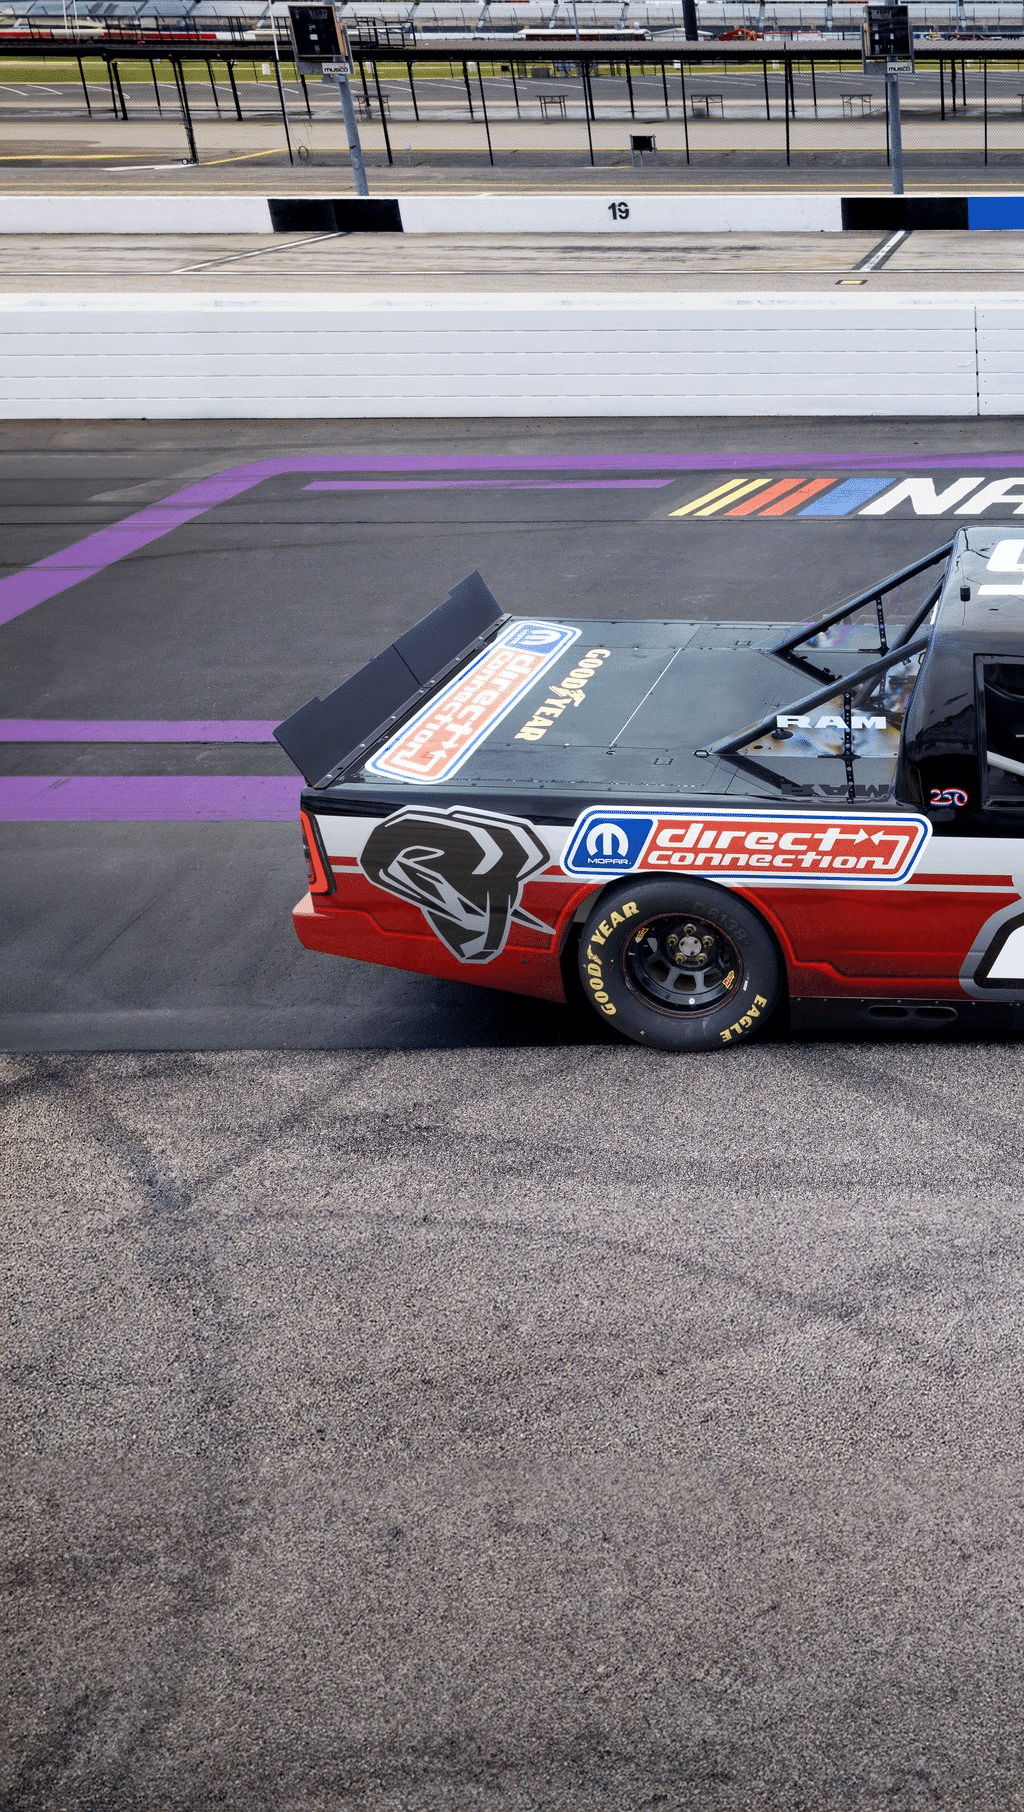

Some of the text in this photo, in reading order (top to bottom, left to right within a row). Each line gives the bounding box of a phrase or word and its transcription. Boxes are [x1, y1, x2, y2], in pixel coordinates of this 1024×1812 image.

[608, 202, 630, 220] 19
[444, 652, 542, 740] direct
[513, 648, 611, 741] GOODYEAR
[776, 714, 887, 730] RAM
[655, 823, 845, 851] direct
[587, 857, 630, 866] MOPAR
[647, 850, 895, 870] connection
[586, 901, 640, 1016] GOODYEAR
[719, 994, 768, 1042] EAGLE
